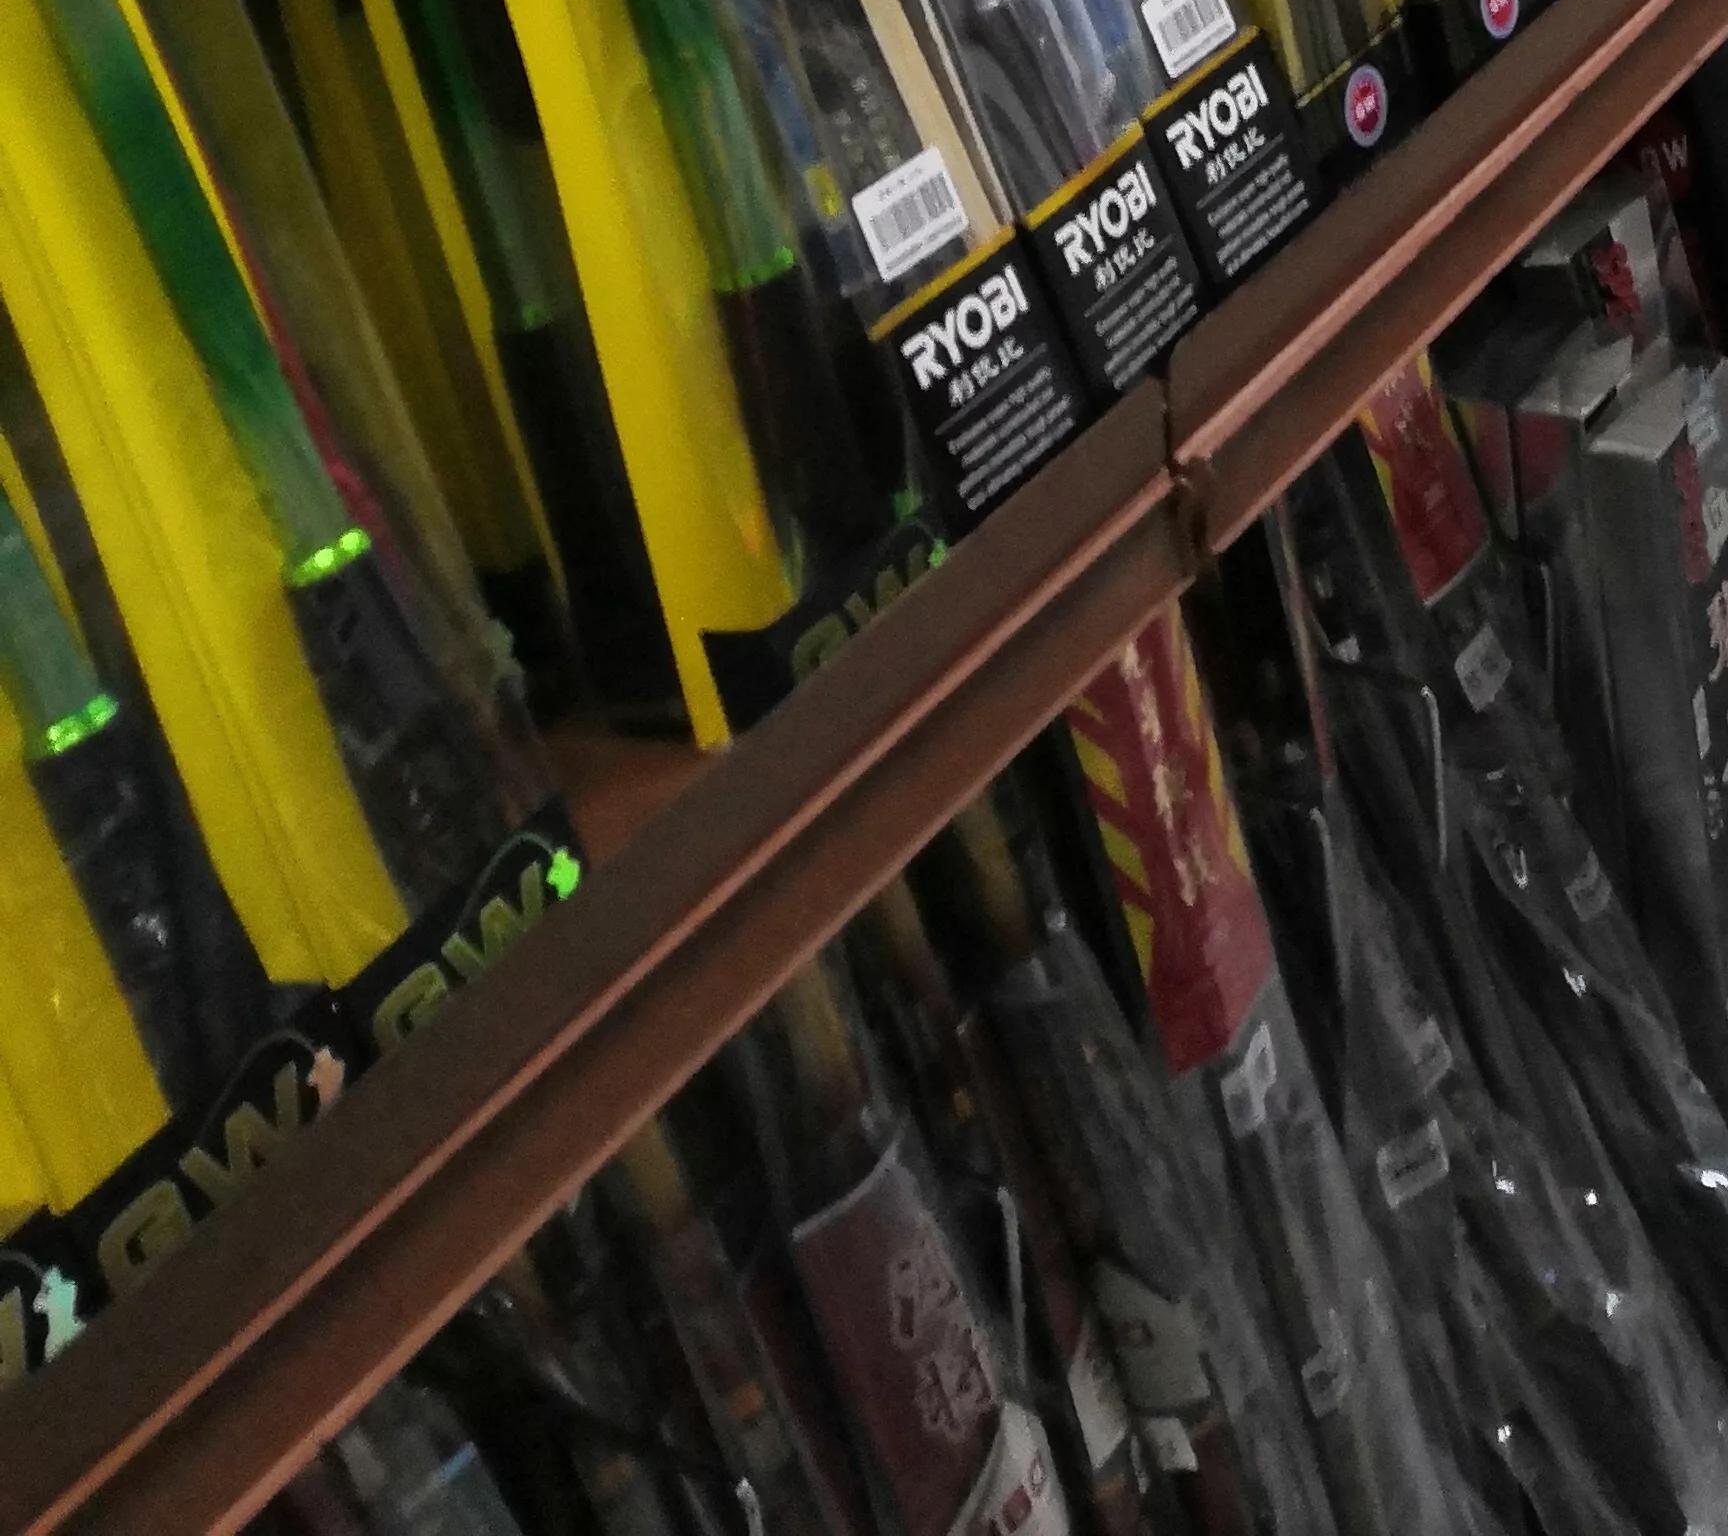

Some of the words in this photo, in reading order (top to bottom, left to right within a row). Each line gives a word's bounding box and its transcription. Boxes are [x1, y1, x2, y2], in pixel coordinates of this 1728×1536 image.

[1165, 61, 1270, 171] RYOBI
[1054, 160, 1158, 277] RYOBI
[900, 264, 1032, 391] RYOBI
